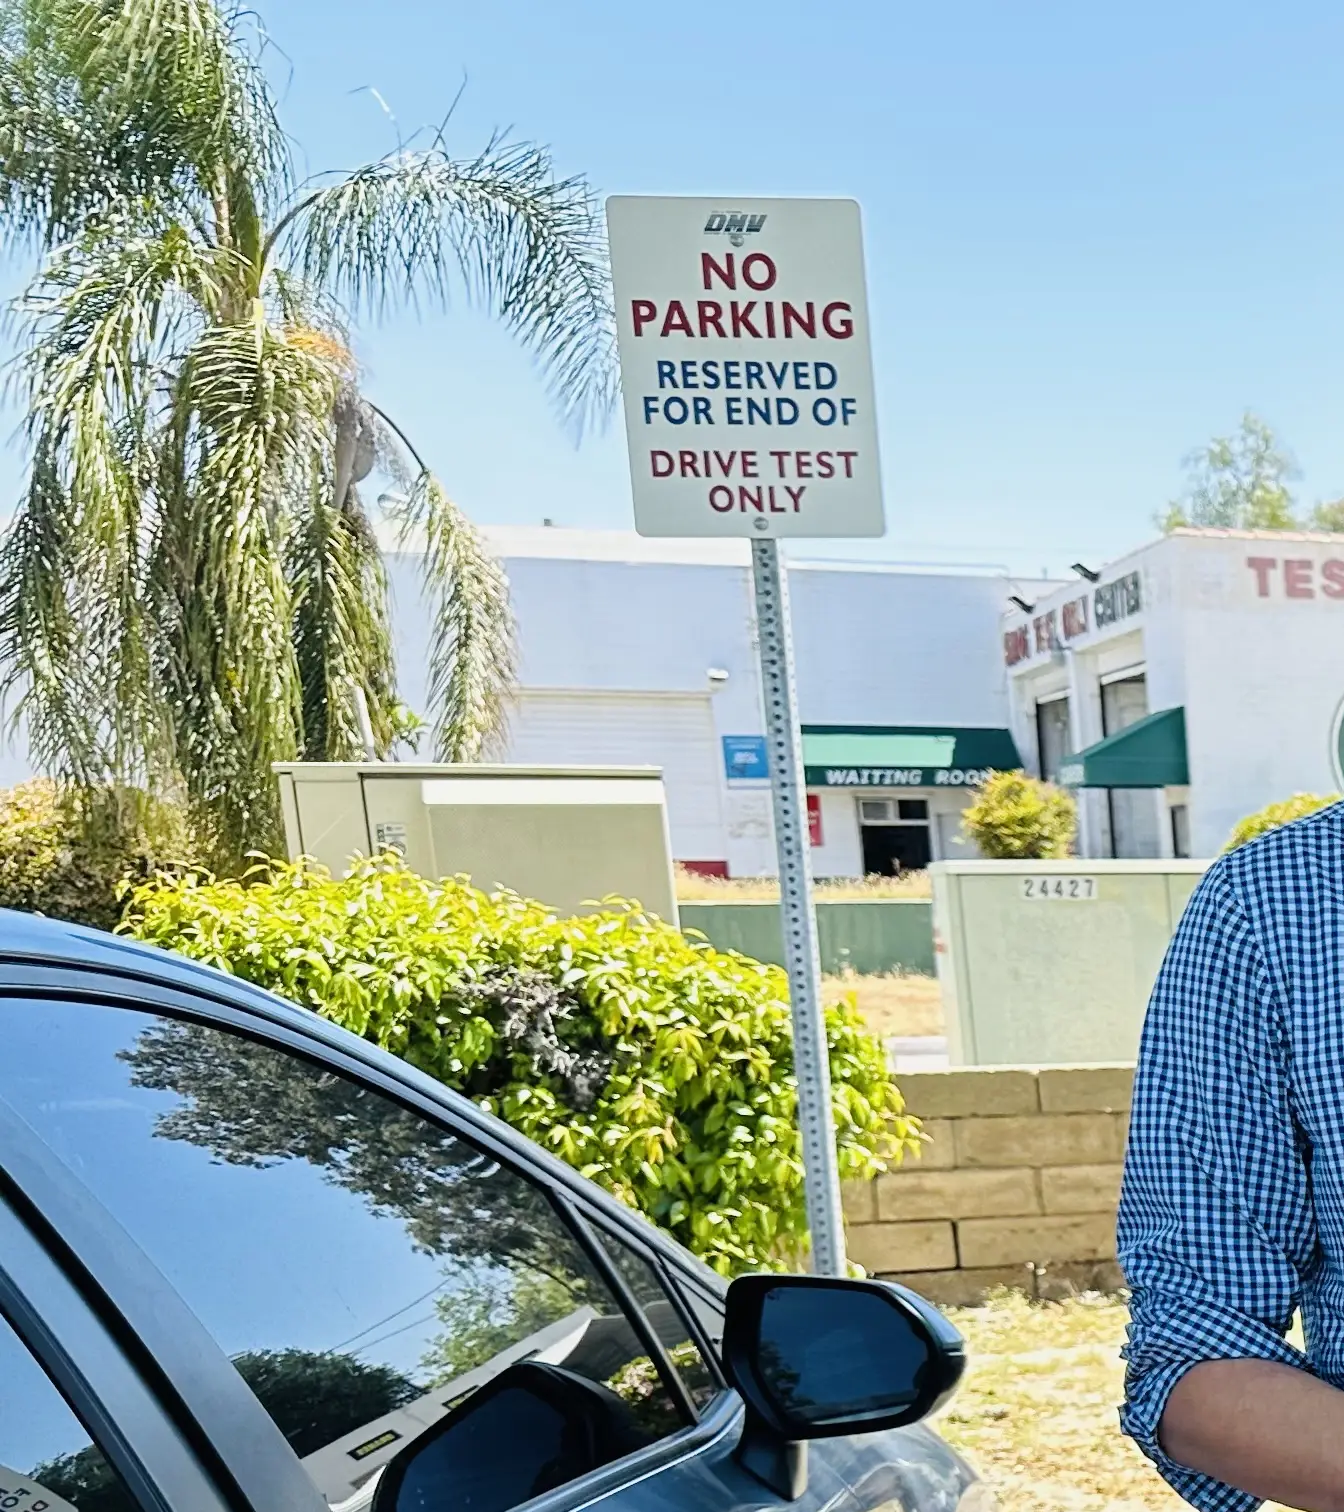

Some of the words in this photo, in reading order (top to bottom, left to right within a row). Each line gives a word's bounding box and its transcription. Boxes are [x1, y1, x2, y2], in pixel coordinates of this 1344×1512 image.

[703, 213, 768, 233] DMV
[701, 252, 777, 291] NO
[631, 300, 854, 339] PARKING
[657, 361, 838, 390] RESERVED
[643, 396, 715, 425] FOR
[726, 397, 800, 426] END
[812, 398, 857, 425] OF
[650, 450, 759, 478] DRIVE
[770, 451, 859, 478] TEST
[708, 485, 806, 513] ONLY
[825, 769, 922, 785] WAITING
[1024, 878, 1095, 898] 24427
